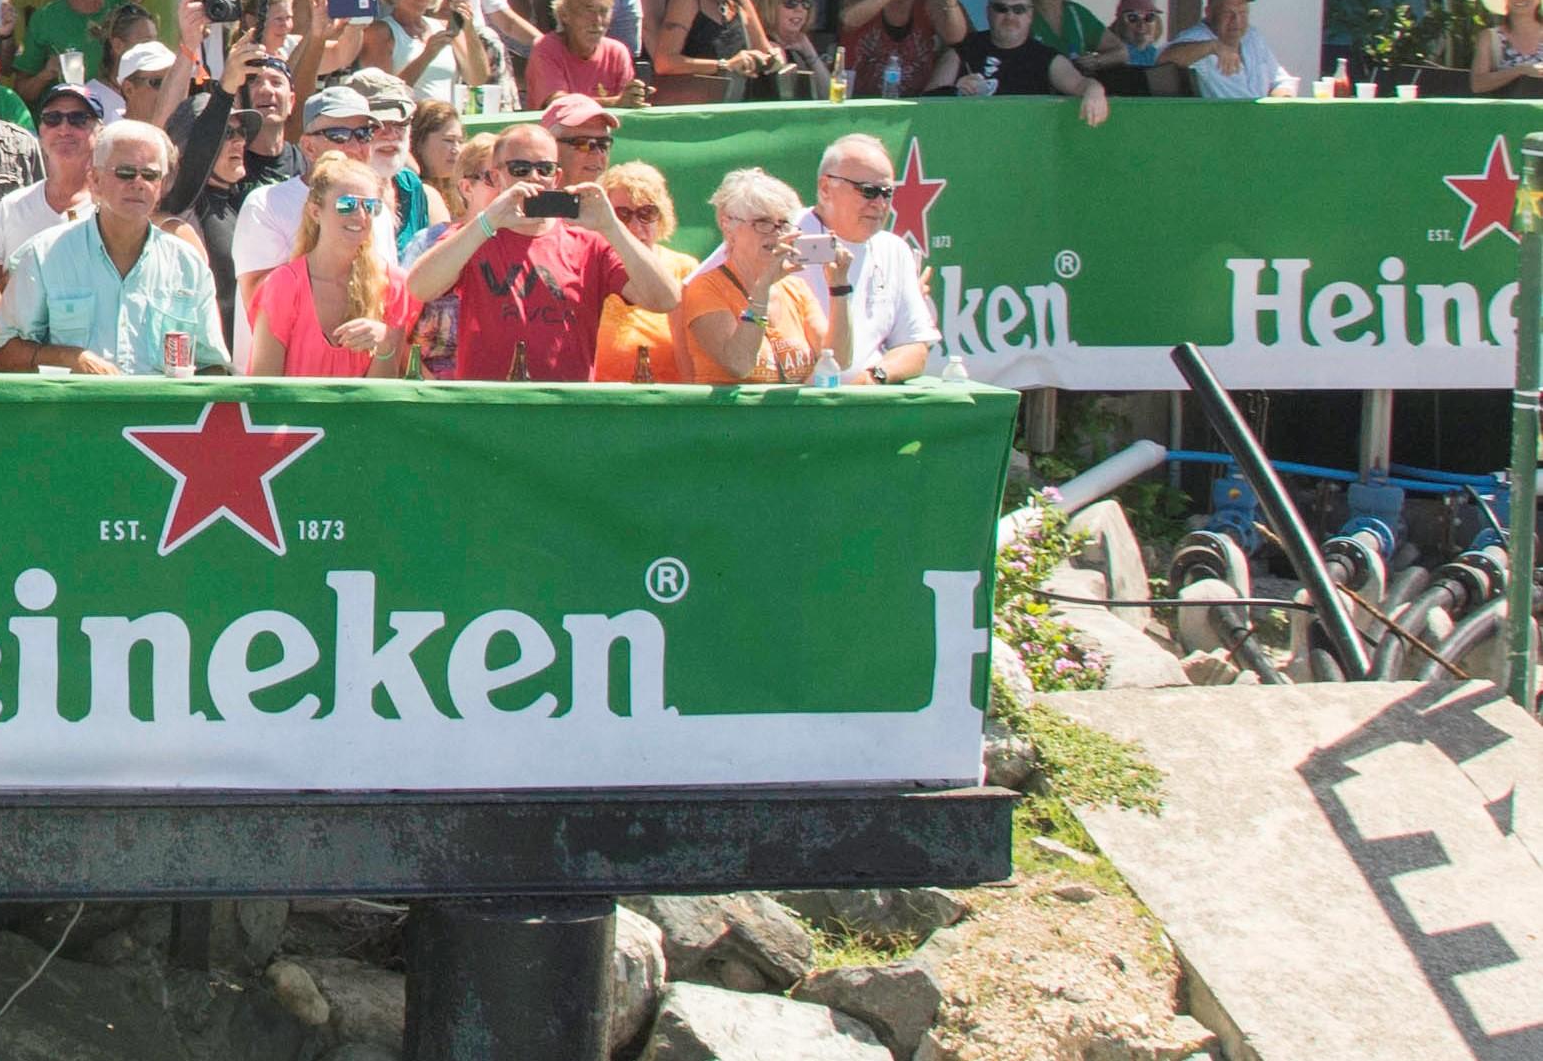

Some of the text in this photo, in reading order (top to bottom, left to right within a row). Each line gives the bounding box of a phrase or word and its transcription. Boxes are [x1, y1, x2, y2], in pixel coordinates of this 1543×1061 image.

[1427, 229, 1455, 242] EST.
[100, 518, 148, 540] EST.
[296, 518, 347, 540] 1873
